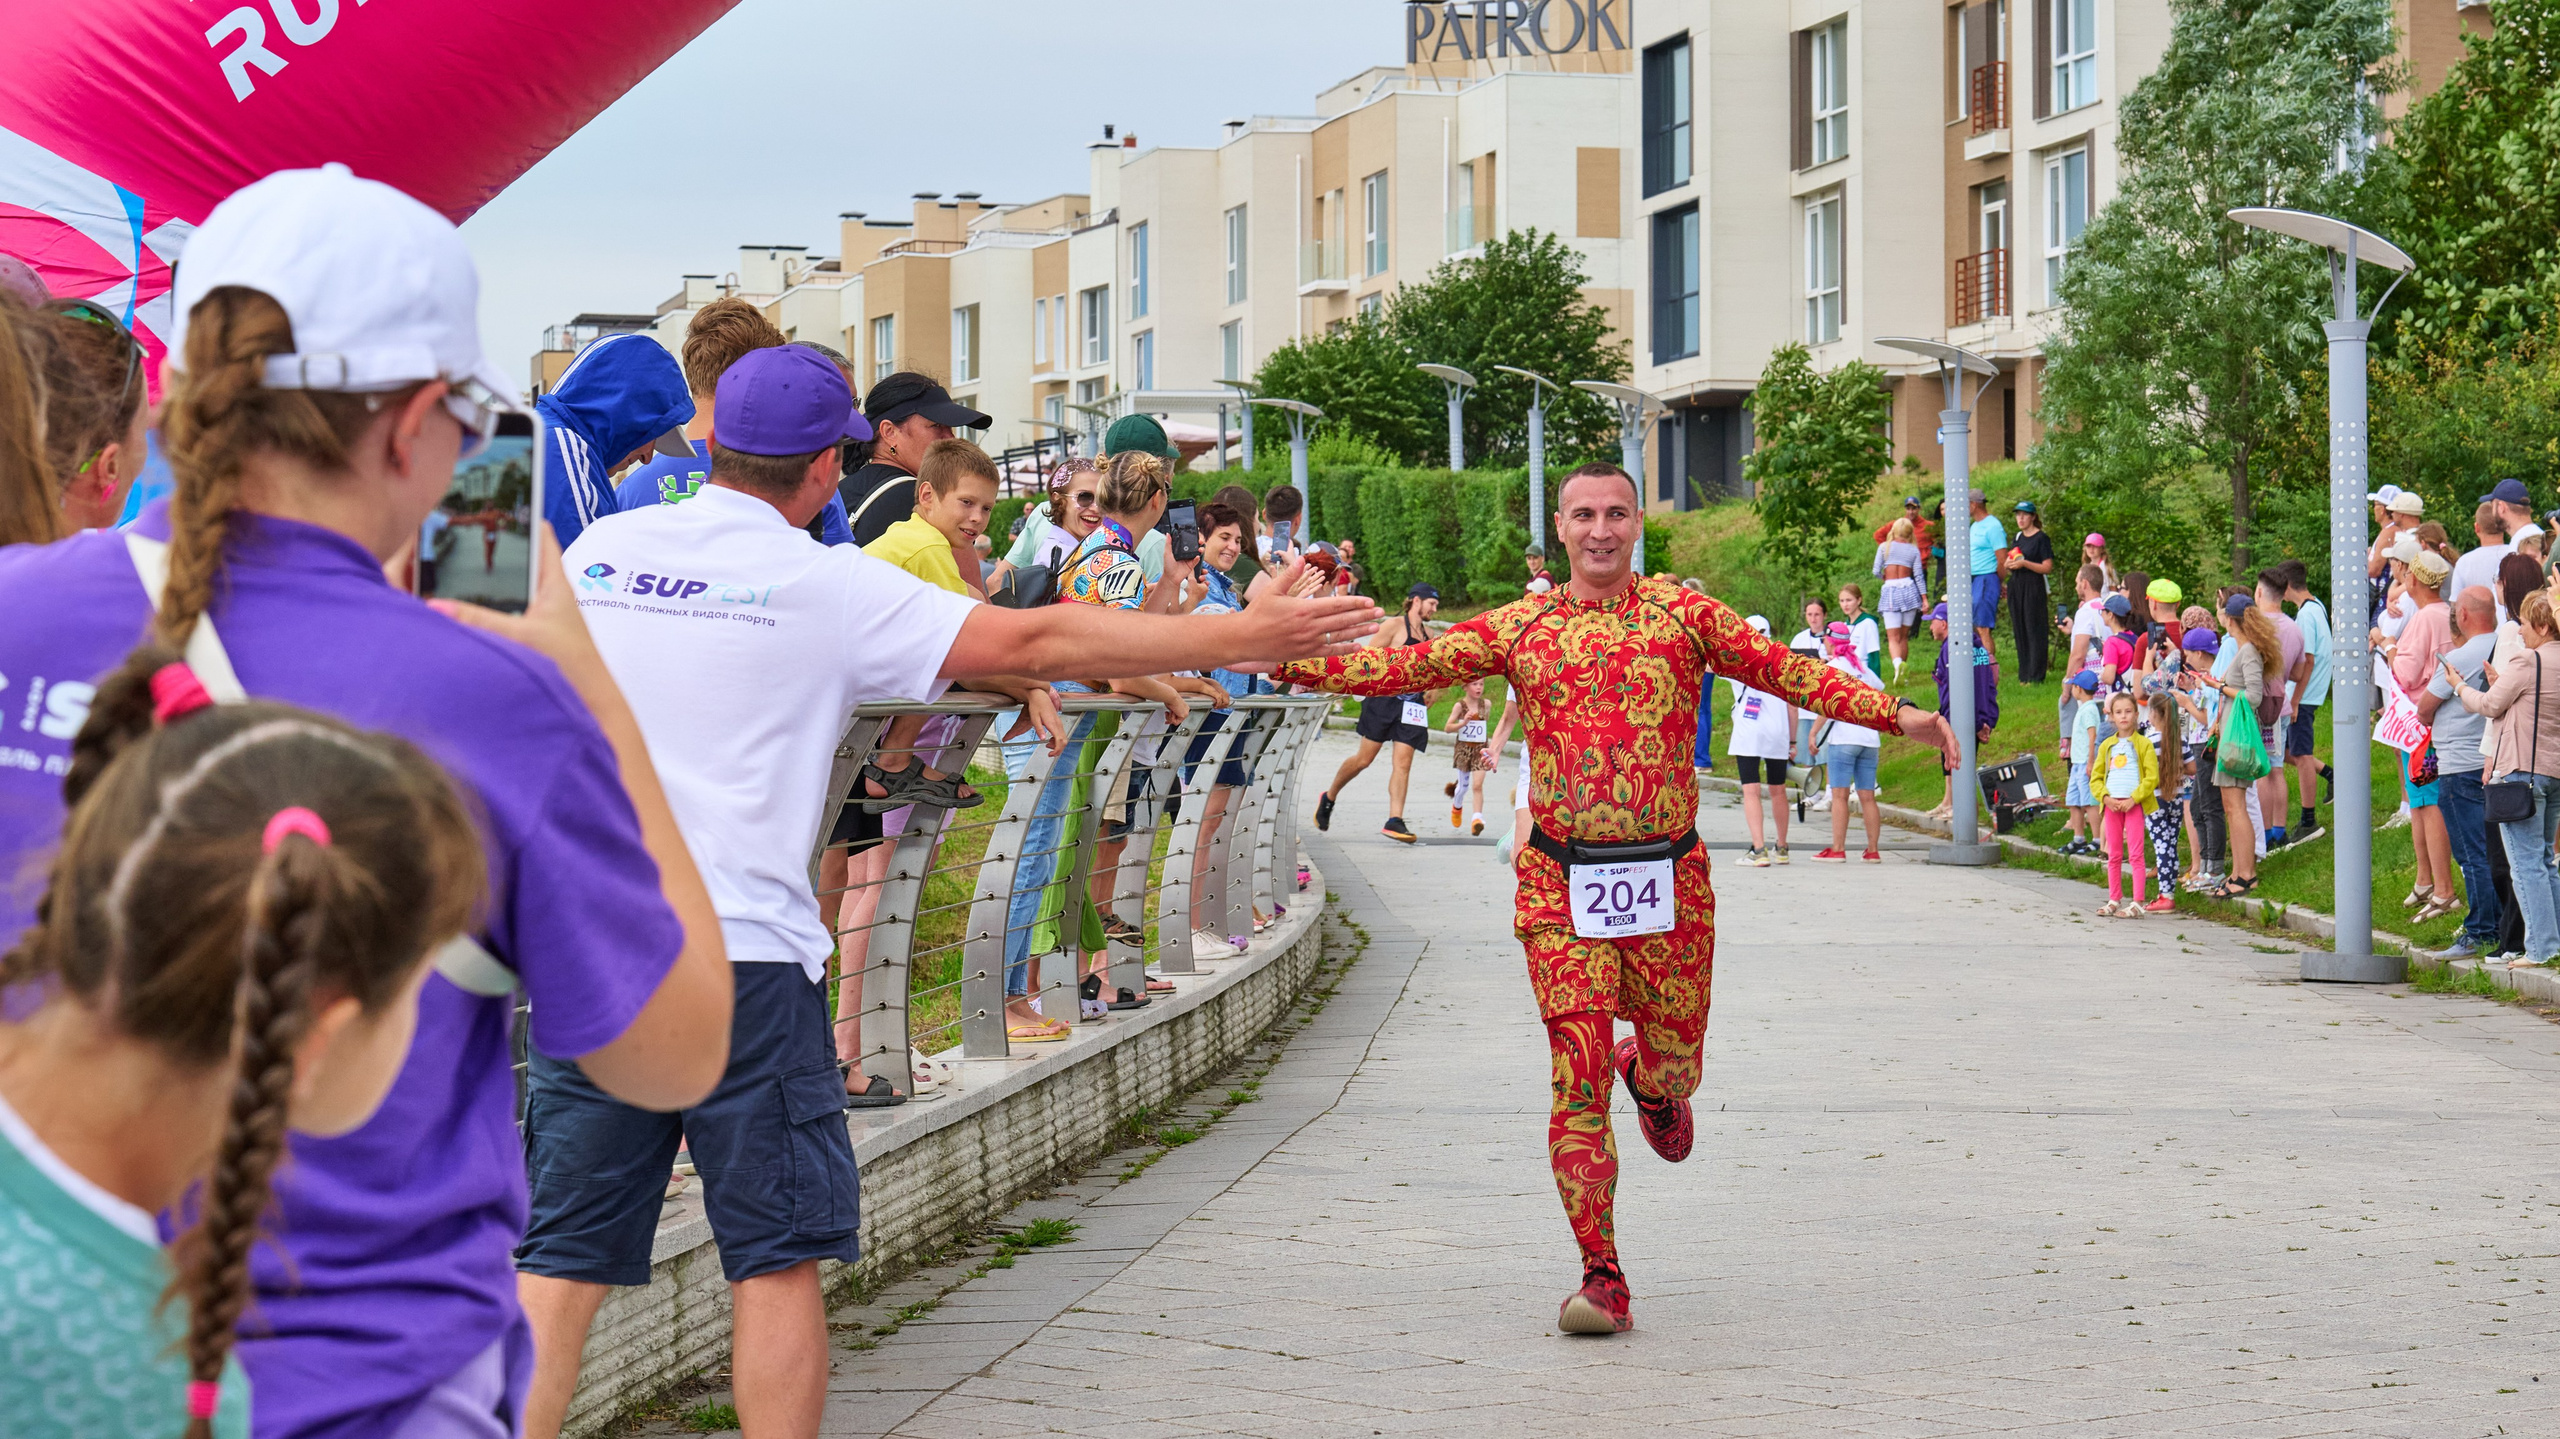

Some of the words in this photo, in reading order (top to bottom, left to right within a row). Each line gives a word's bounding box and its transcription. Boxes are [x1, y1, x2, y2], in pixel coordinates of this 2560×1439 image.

[205, 0, 369, 103] RU
[633, 604, 689, 617] пляжных
[692, 609, 729, 620] видов
[732, 612, 776, 627] спорта
[1406, 707, 1425, 719] 410
[1462, 725, 1483, 736] 270
[1610, 866, 1648, 876] SUPFEST
[1584, 878, 1660, 914] 204
[1609, 914, 1632, 926] 1600
